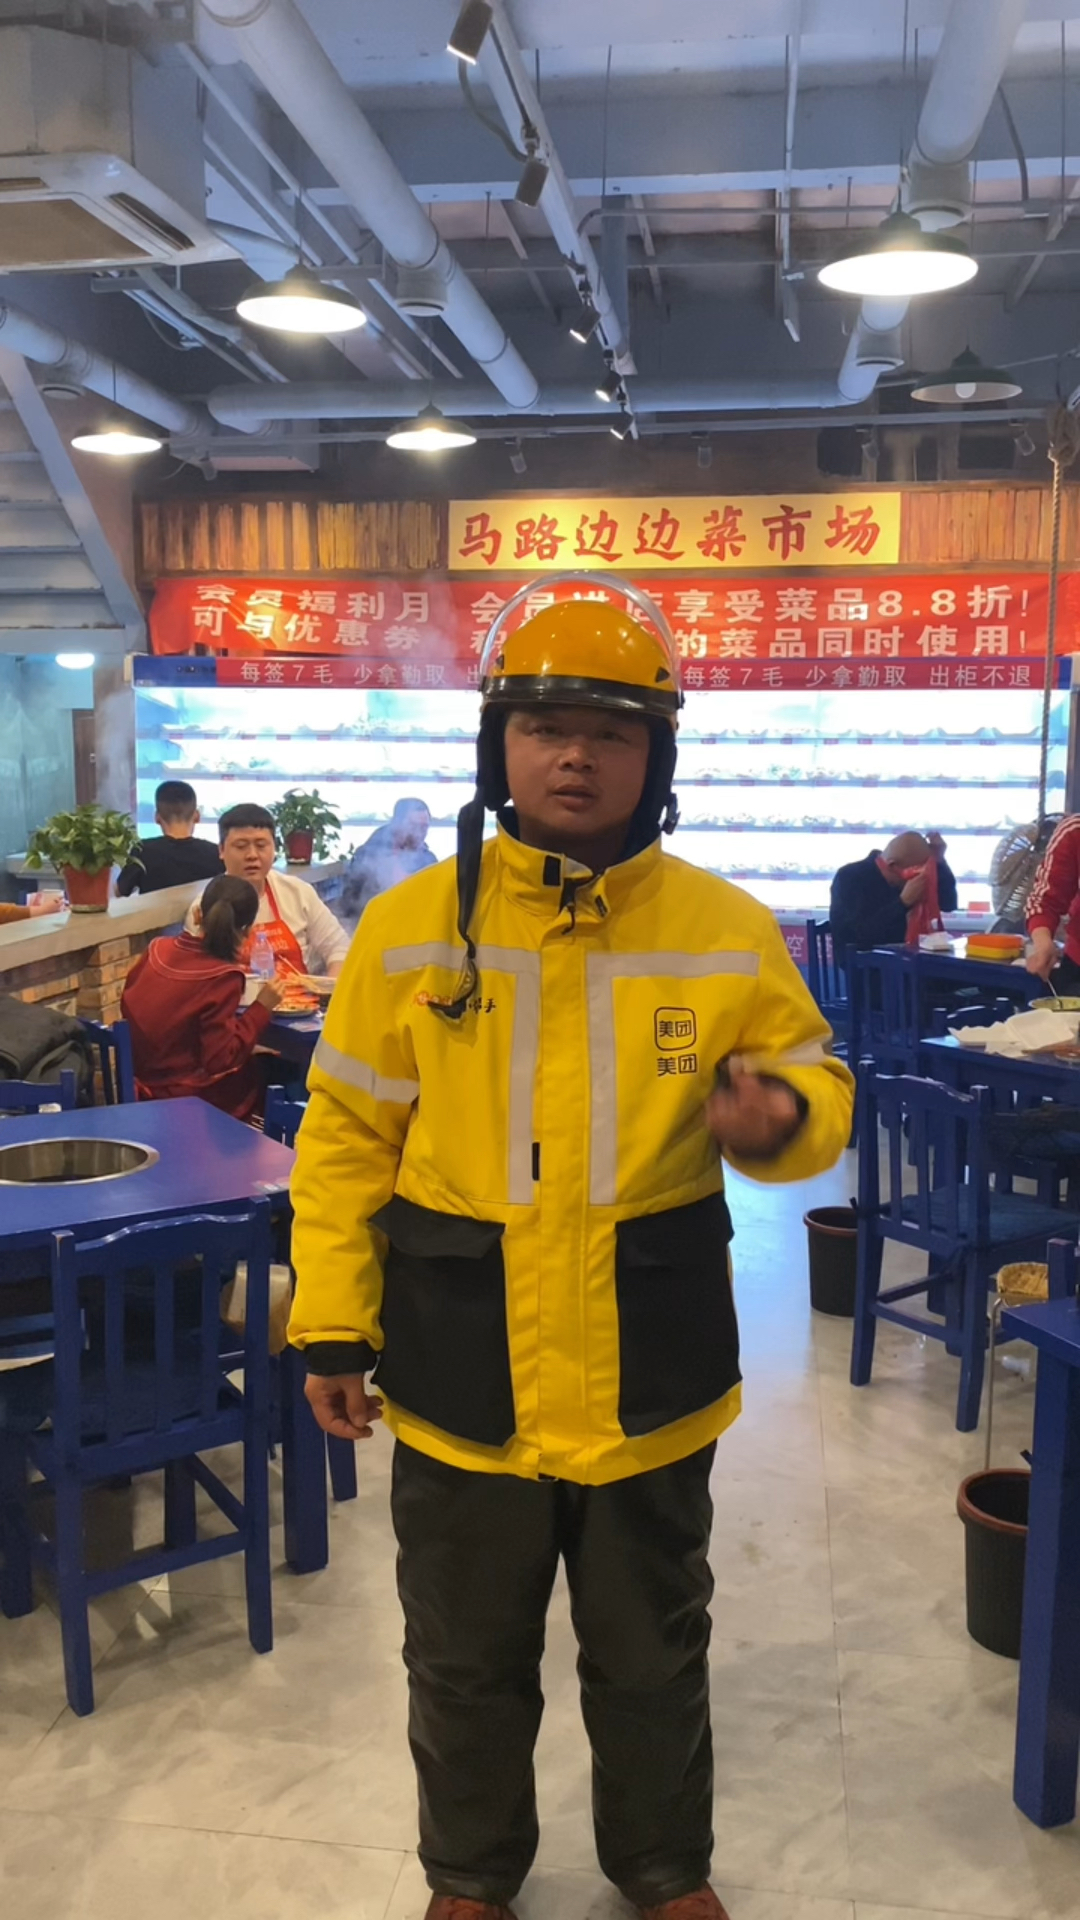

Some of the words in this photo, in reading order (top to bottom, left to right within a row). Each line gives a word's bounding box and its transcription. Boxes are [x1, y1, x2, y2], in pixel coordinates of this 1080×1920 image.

[459, 505, 881, 565] 马路边边菜市场
[192, 606, 420, 649] 可与优惠券
[241, 662, 333, 684] 每签7毛
[354, 662, 446, 686] 少拿勤取
[684, 666, 783, 688] 每签7毛
[805, 665, 906, 688] 少拿勤取
[929, 665, 1031, 688] 出柜不退
[658, 1019, 692, 1039] 美团
[656, 1053, 698, 1077] 美团
